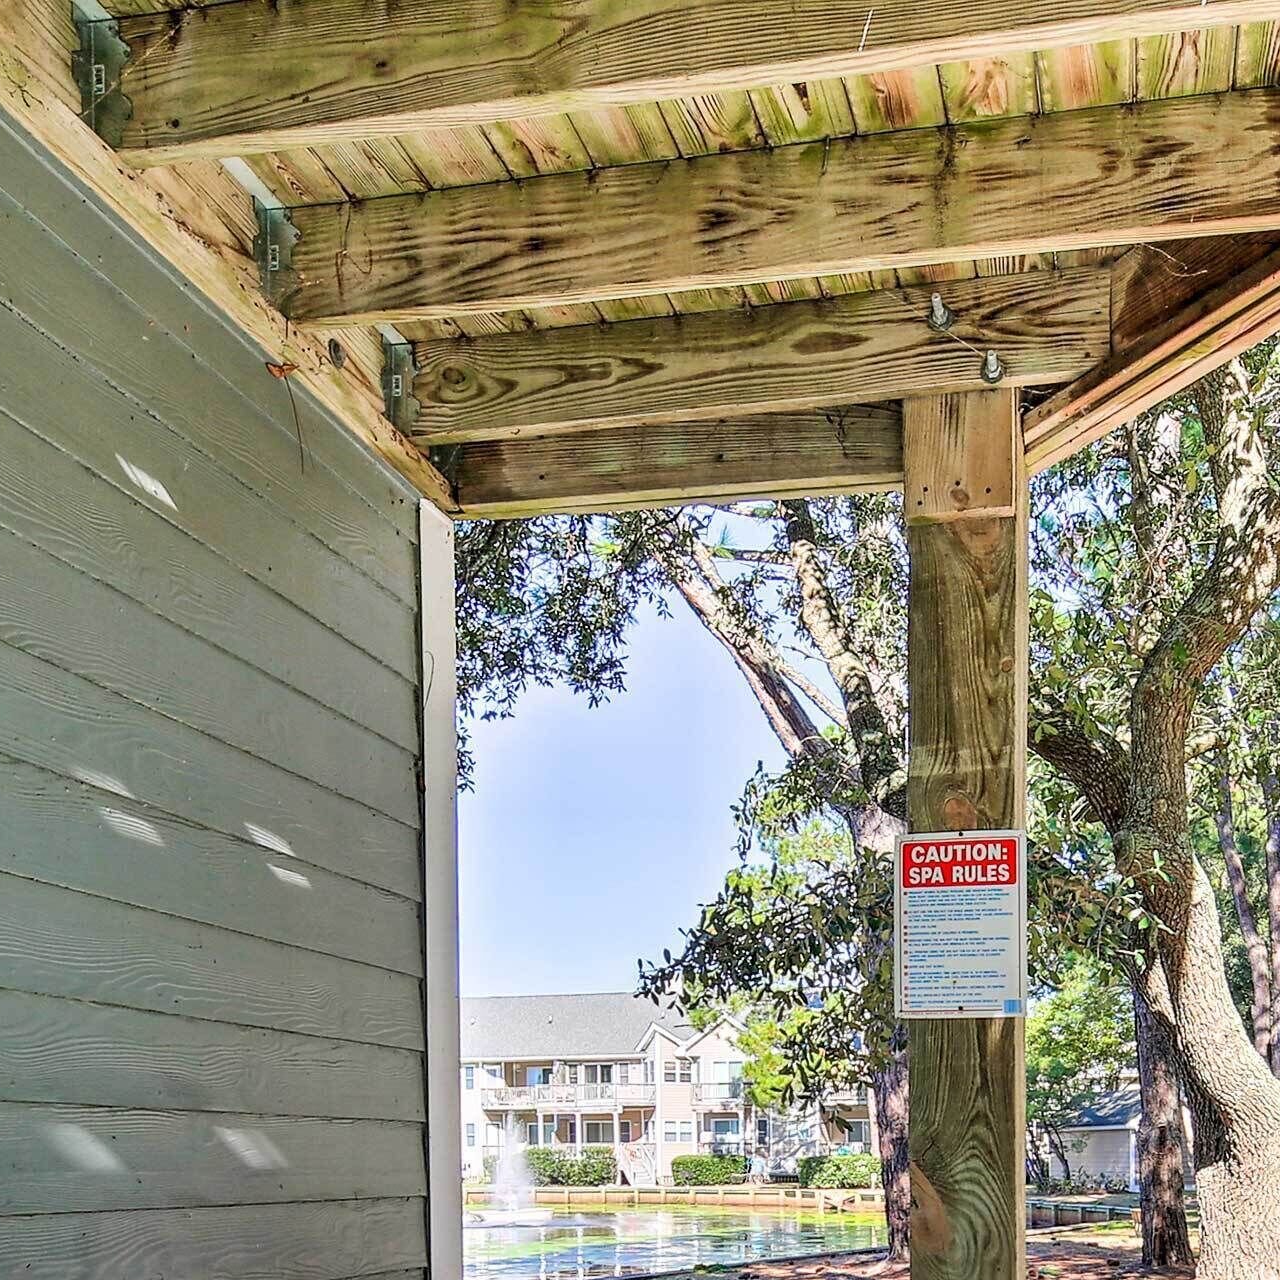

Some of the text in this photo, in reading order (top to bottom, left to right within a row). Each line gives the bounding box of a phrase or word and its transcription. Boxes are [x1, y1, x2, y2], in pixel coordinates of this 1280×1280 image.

[911, 843, 1008, 864] CAUTION:
[909, 864, 1010, 885] SPA RULES
